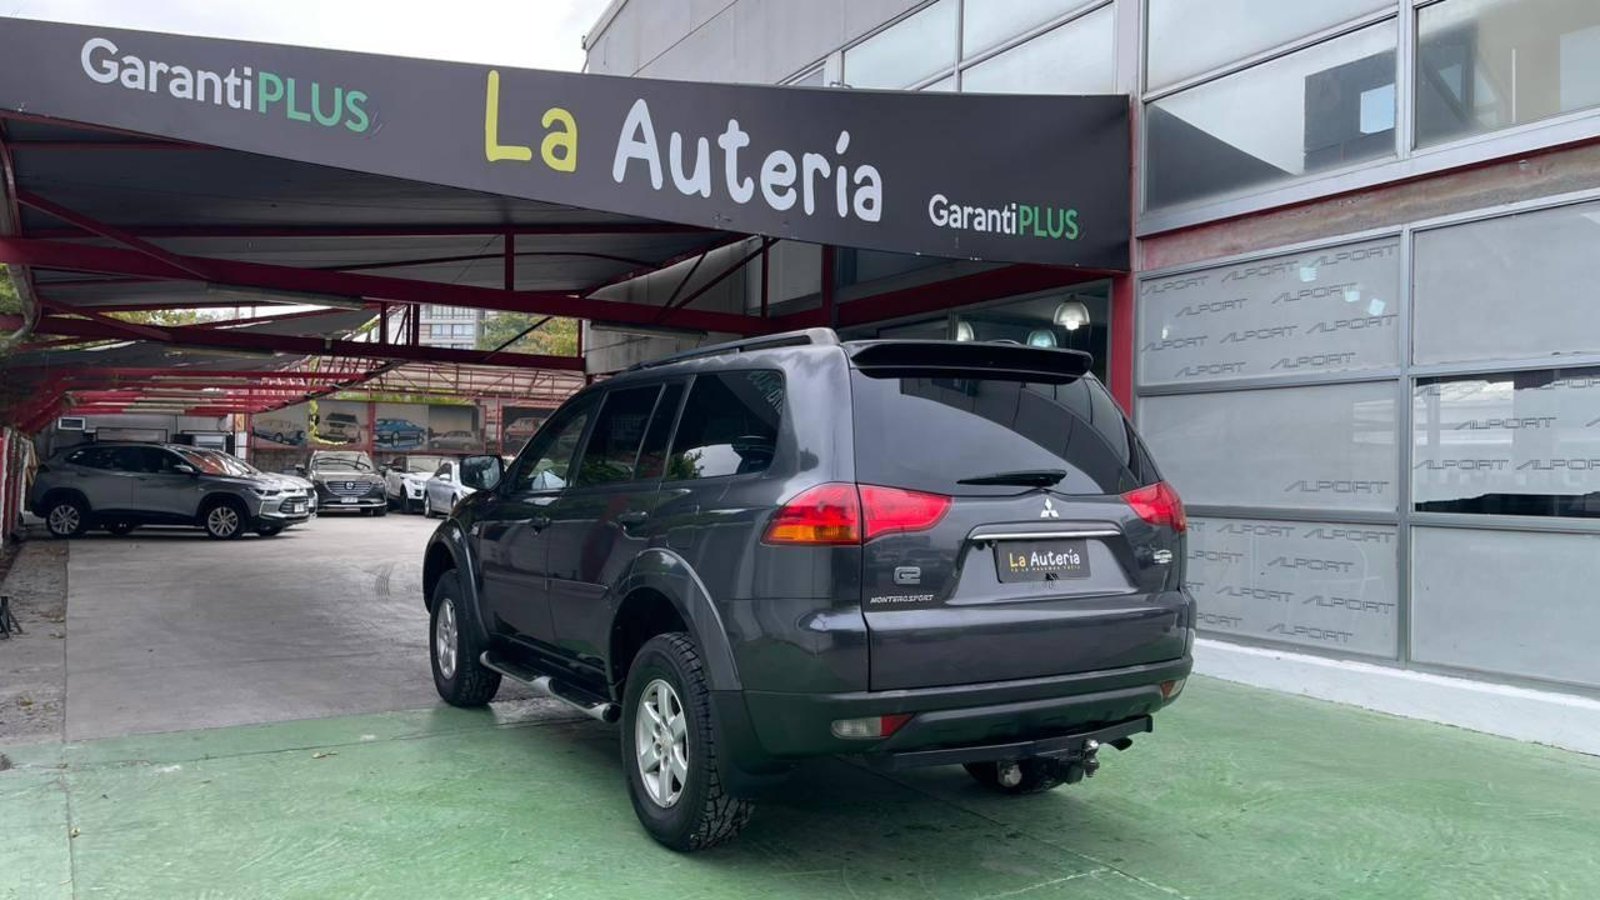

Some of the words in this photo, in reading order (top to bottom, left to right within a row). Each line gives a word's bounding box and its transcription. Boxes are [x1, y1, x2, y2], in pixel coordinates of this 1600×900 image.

[80, 37, 371, 133] GarantiPLUS
[484, 69, 578, 172] La
[611, 97, 883, 223] Autería
[928, 193, 1080, 240] GarantiPLUS
[1516, 459, 1600, 470] ALPOR
[1009, 552, 1026, 568] La
[1030, 549, 1081, 567] Autería
